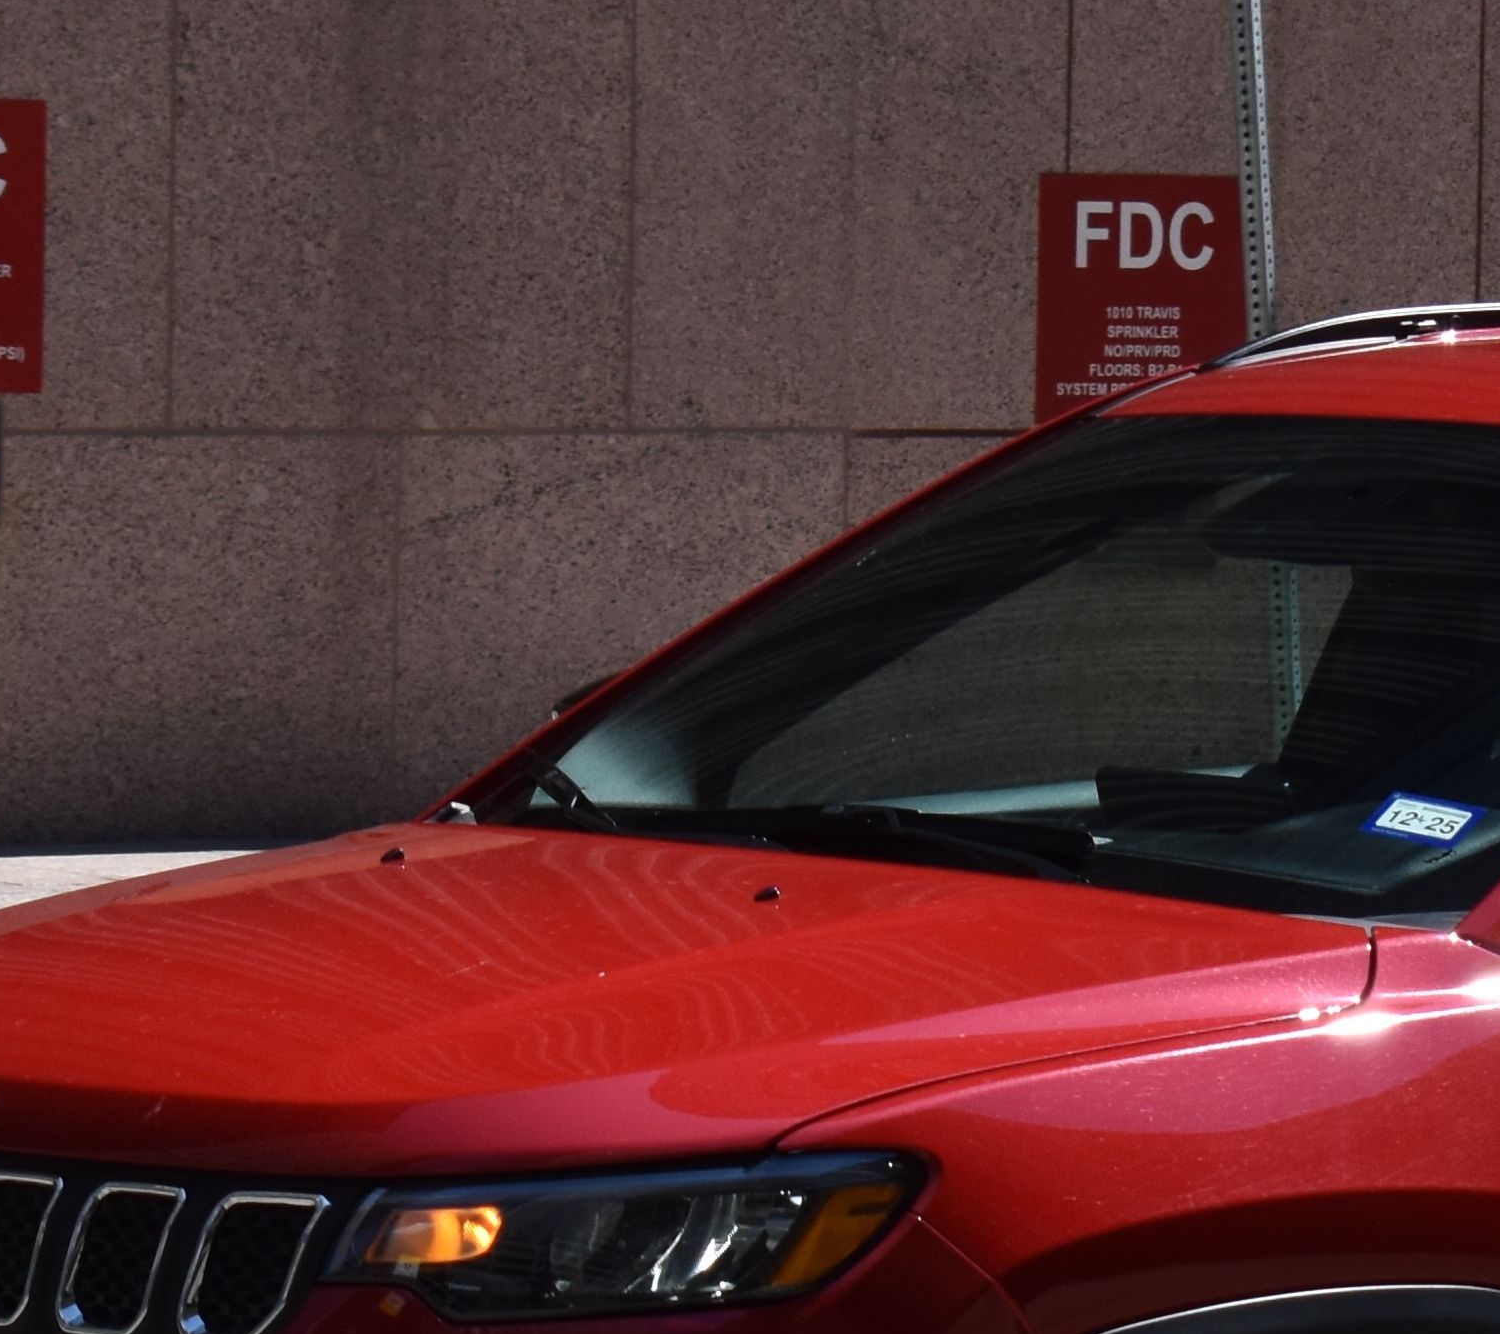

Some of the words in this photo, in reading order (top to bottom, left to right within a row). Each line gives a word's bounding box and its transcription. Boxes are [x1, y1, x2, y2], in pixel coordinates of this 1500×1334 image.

[1075, 200, 1214, 271] FDC
[1106, 306, 1132, 319] 1010
[1136, 306, 1181, 320] TRAVIS
[1107, 326, 1178, 338] SPRINKLER
[1089, 363, 1144, 376] FLOORS:
[1056, 383, 1107, 396] SYSTEM
[1388, 810, 1418, 827] 12
[1425, 816, 1460, 835] 25
